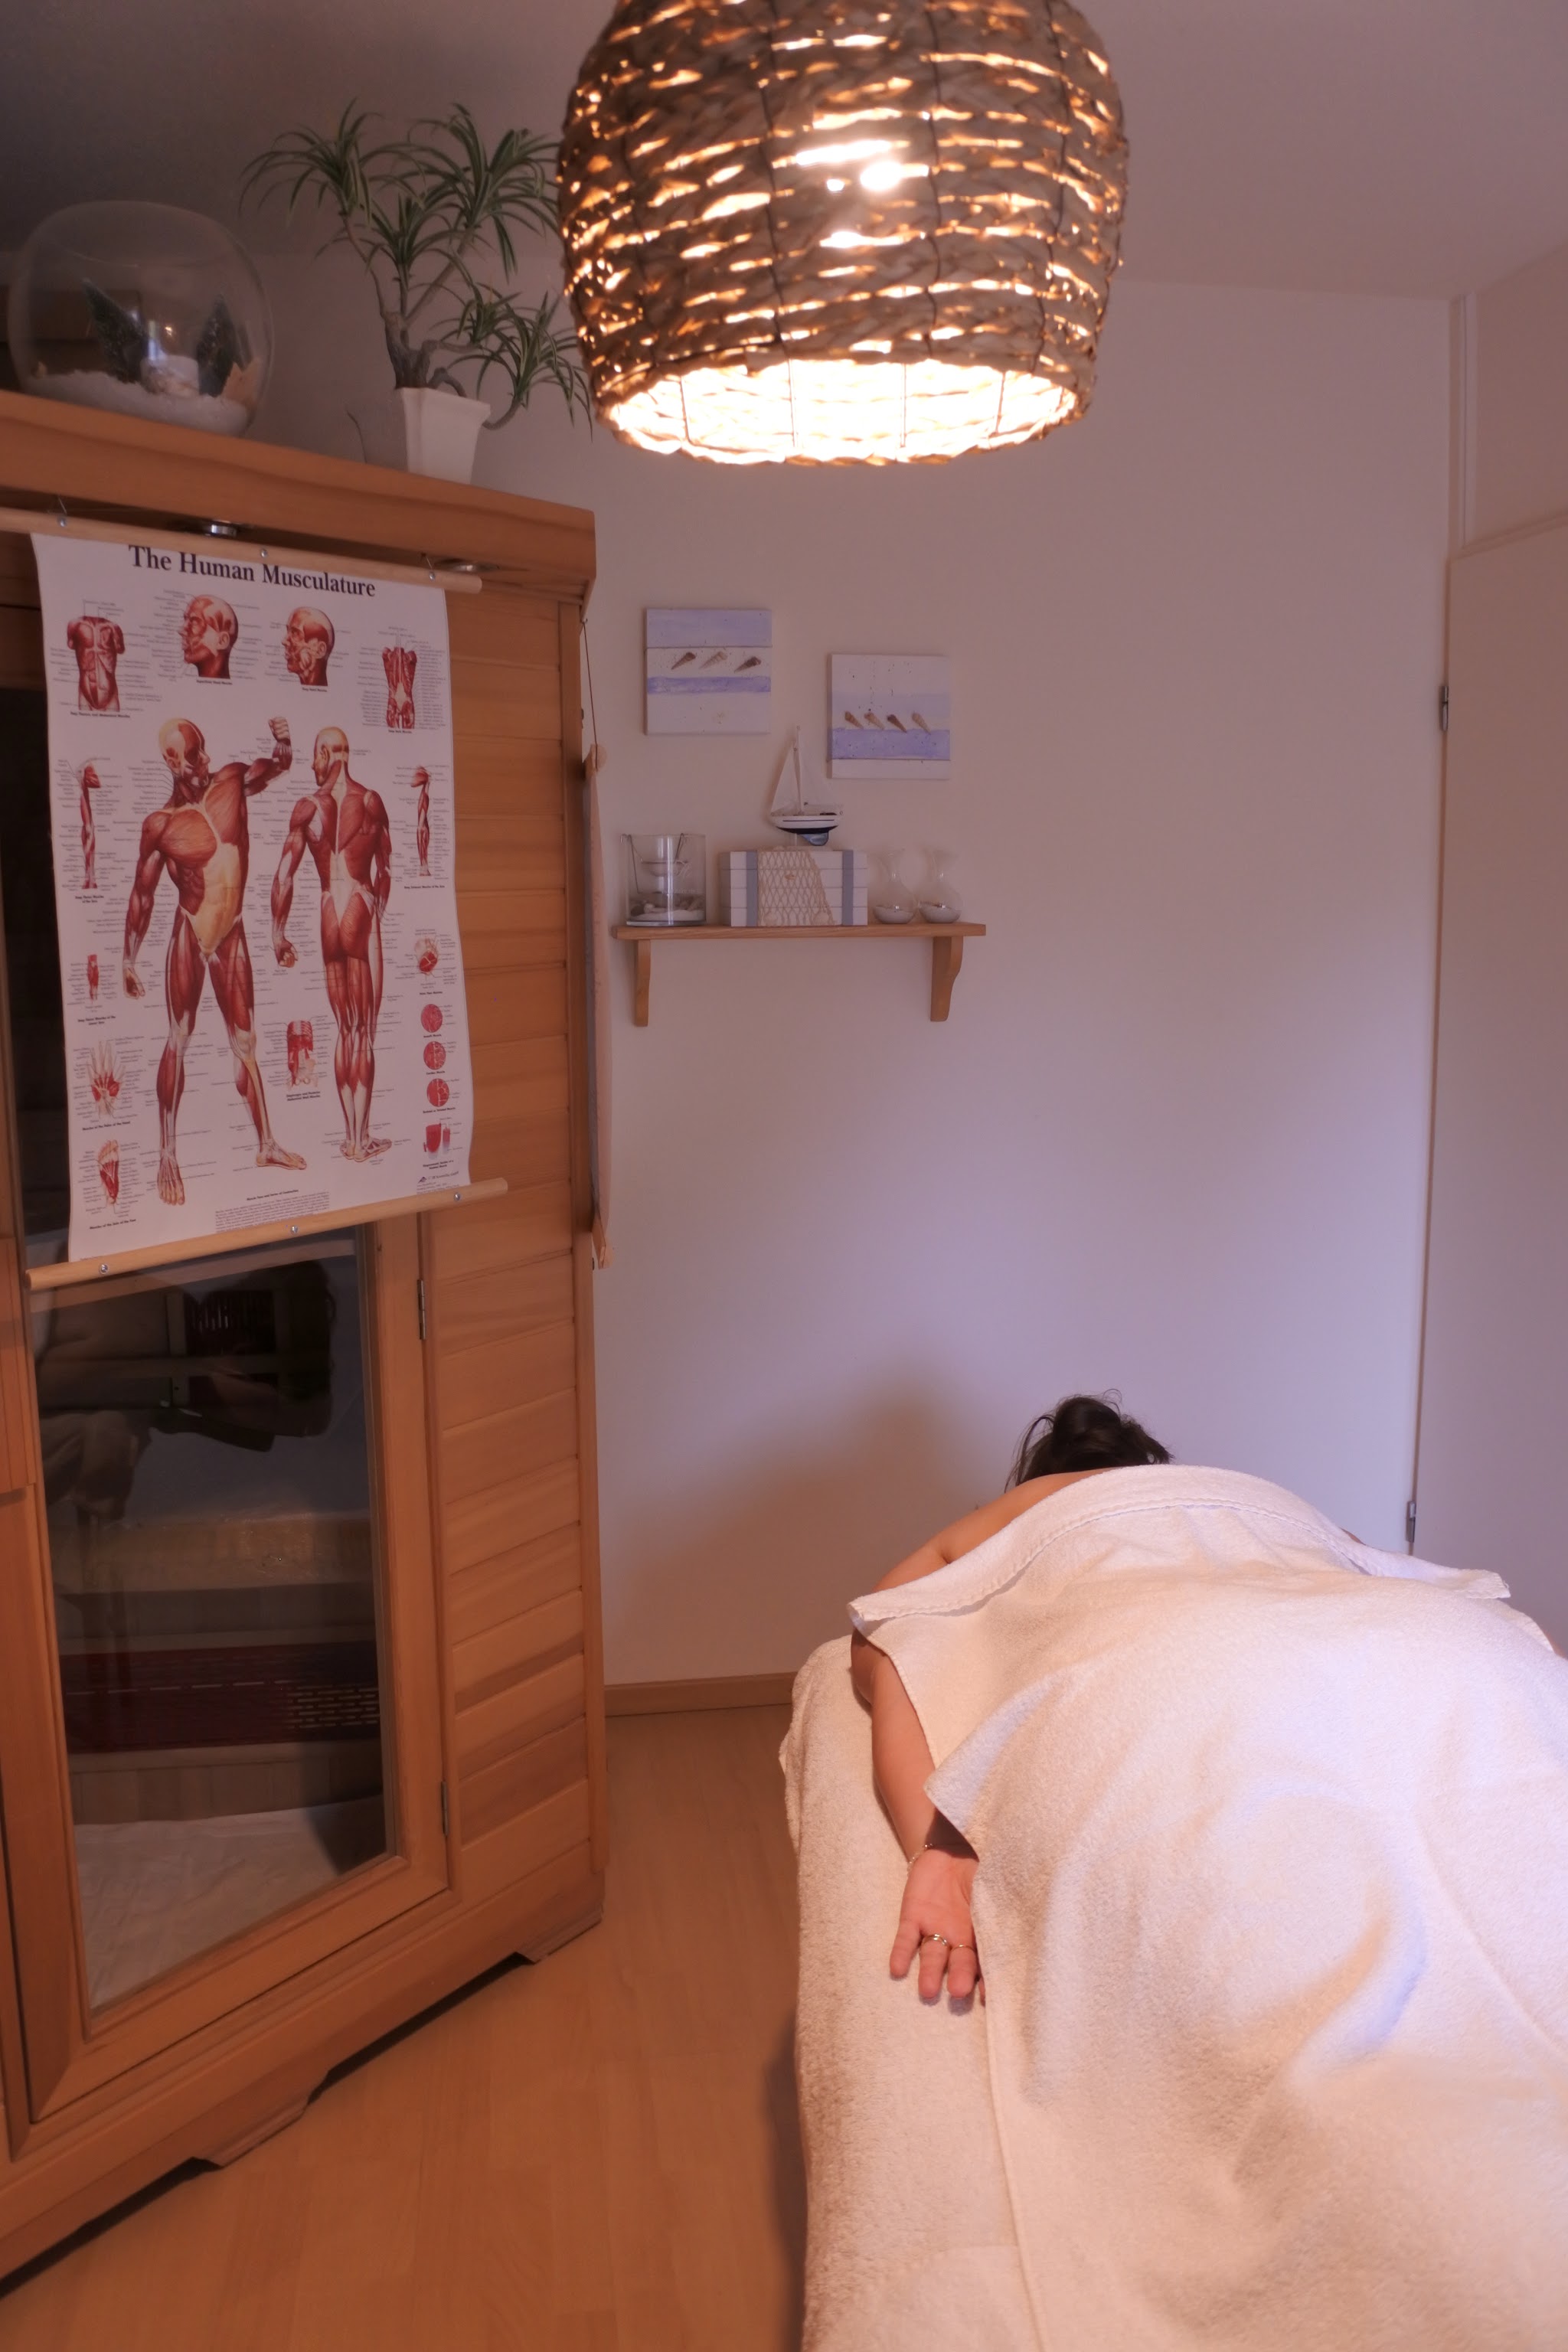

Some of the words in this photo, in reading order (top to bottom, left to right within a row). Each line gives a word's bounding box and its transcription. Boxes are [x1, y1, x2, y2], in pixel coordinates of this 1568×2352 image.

[128, 544, 172, 571] The
[178, 551, 255, 582] Human
[262, 564, 376, 597] Musculature
